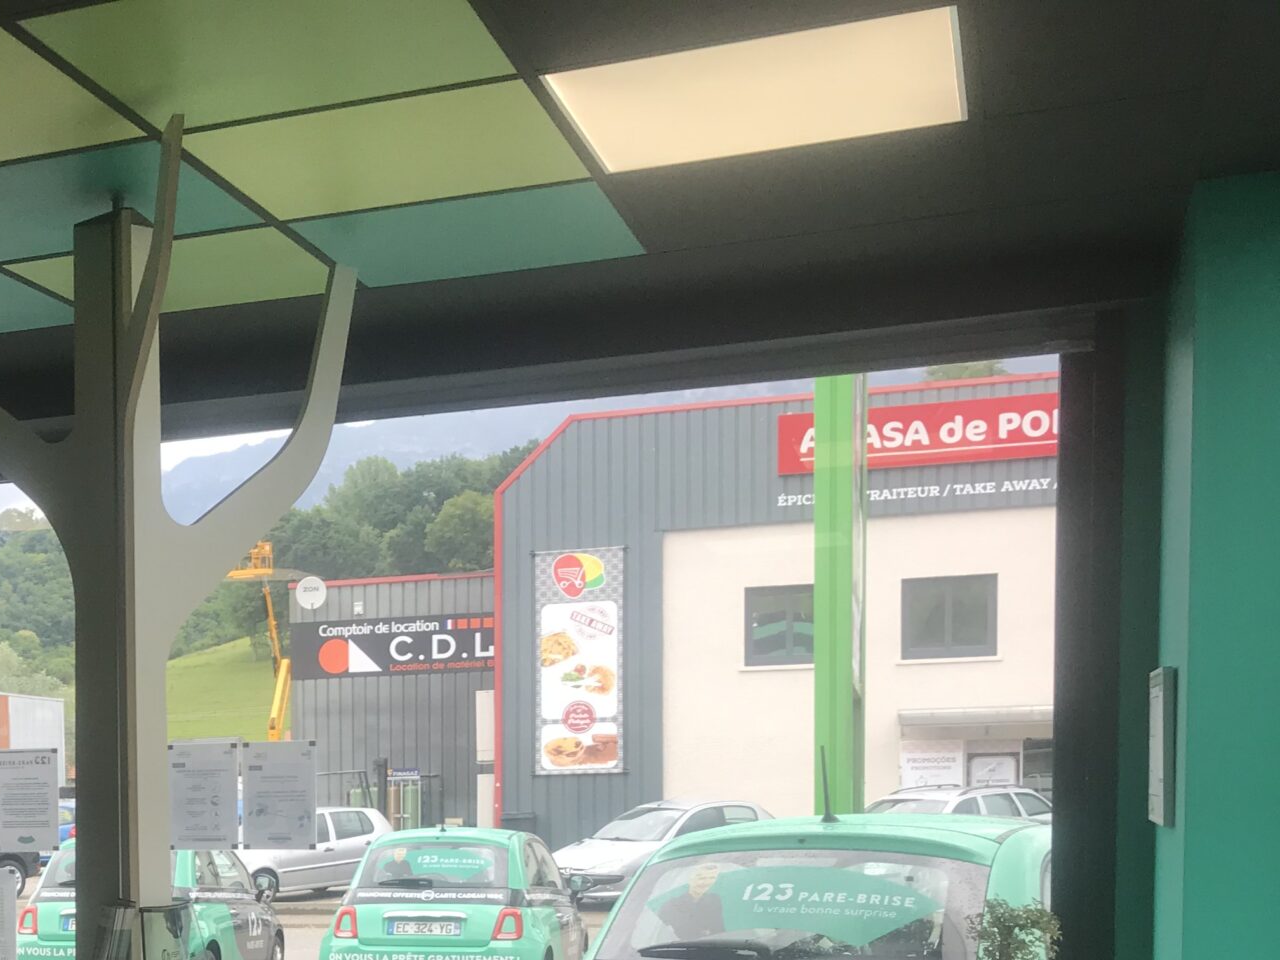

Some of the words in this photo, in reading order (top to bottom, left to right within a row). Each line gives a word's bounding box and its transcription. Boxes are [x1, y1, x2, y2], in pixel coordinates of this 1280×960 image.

[866, 420, 930, 450] ASA
[939, 415, 988, 443] de
[953, 482, 996, 496] TAKE
[1000, 478, 1052, 493] AWAY
[318, 624, 373, 638] Comptoir
[374, 624, 390, 634] de
[391, 619, 440, 633] location
[389, 663, 430, 672] Location
[431, 662, 444, 671] de
[742, 883, 795, 901] 123
[798, 891, 916, 908] PARE-BRISE
[753, 903, 764, 914] la
[766, 904, 797, 914] vraie
[800, 904, 840, 915] bonne
[844, 907, 897, 919] surprise
[26, 947, 52, 957] VOUS
[53, 947, 65, 957] LA
